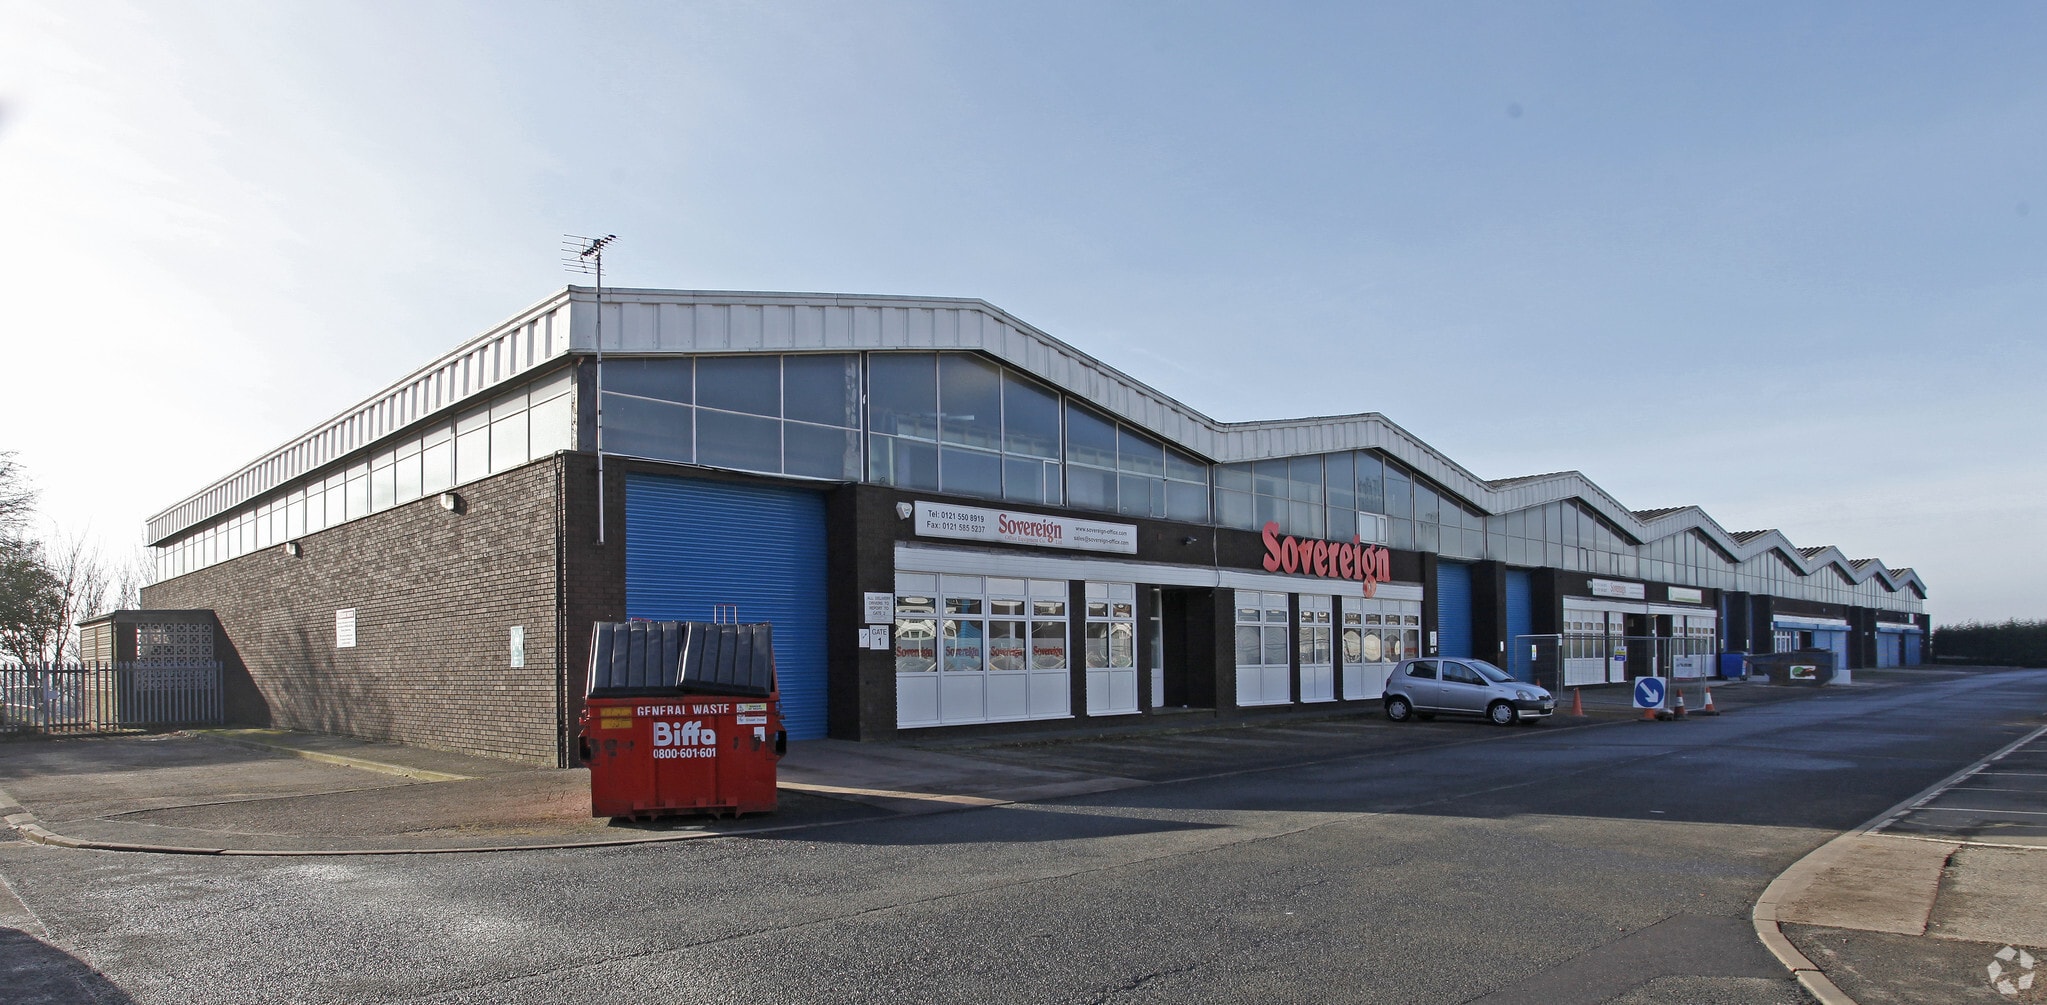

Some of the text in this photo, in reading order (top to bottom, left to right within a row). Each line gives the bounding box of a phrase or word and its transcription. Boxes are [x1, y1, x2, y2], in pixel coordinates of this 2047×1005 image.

[928, 510, 940, 518] Tel:
[941, 511, 956, 520] 0121
[958, 513, 969, 521] 550
[926, 521, 941, 529] Fax:
[942, 523, 957, 531] 0121
[998, 513, 1062, 543] Sovereign
[1262, 520, 1391, 599] Sovereign
[871, 628, 887, 636] GATE
[878, 637, 882, 646] 1
[896, 646, 933, 659] Sovereign
[946, 646, 980, 659] Sovereign
[990, 646, 1023, 658] Sovereign
[1033, 645, 1063, 657] Sovereign
[637, 703, 730, 716] GENERAL WASTE
[653, 721, 716, 746] Biffa
